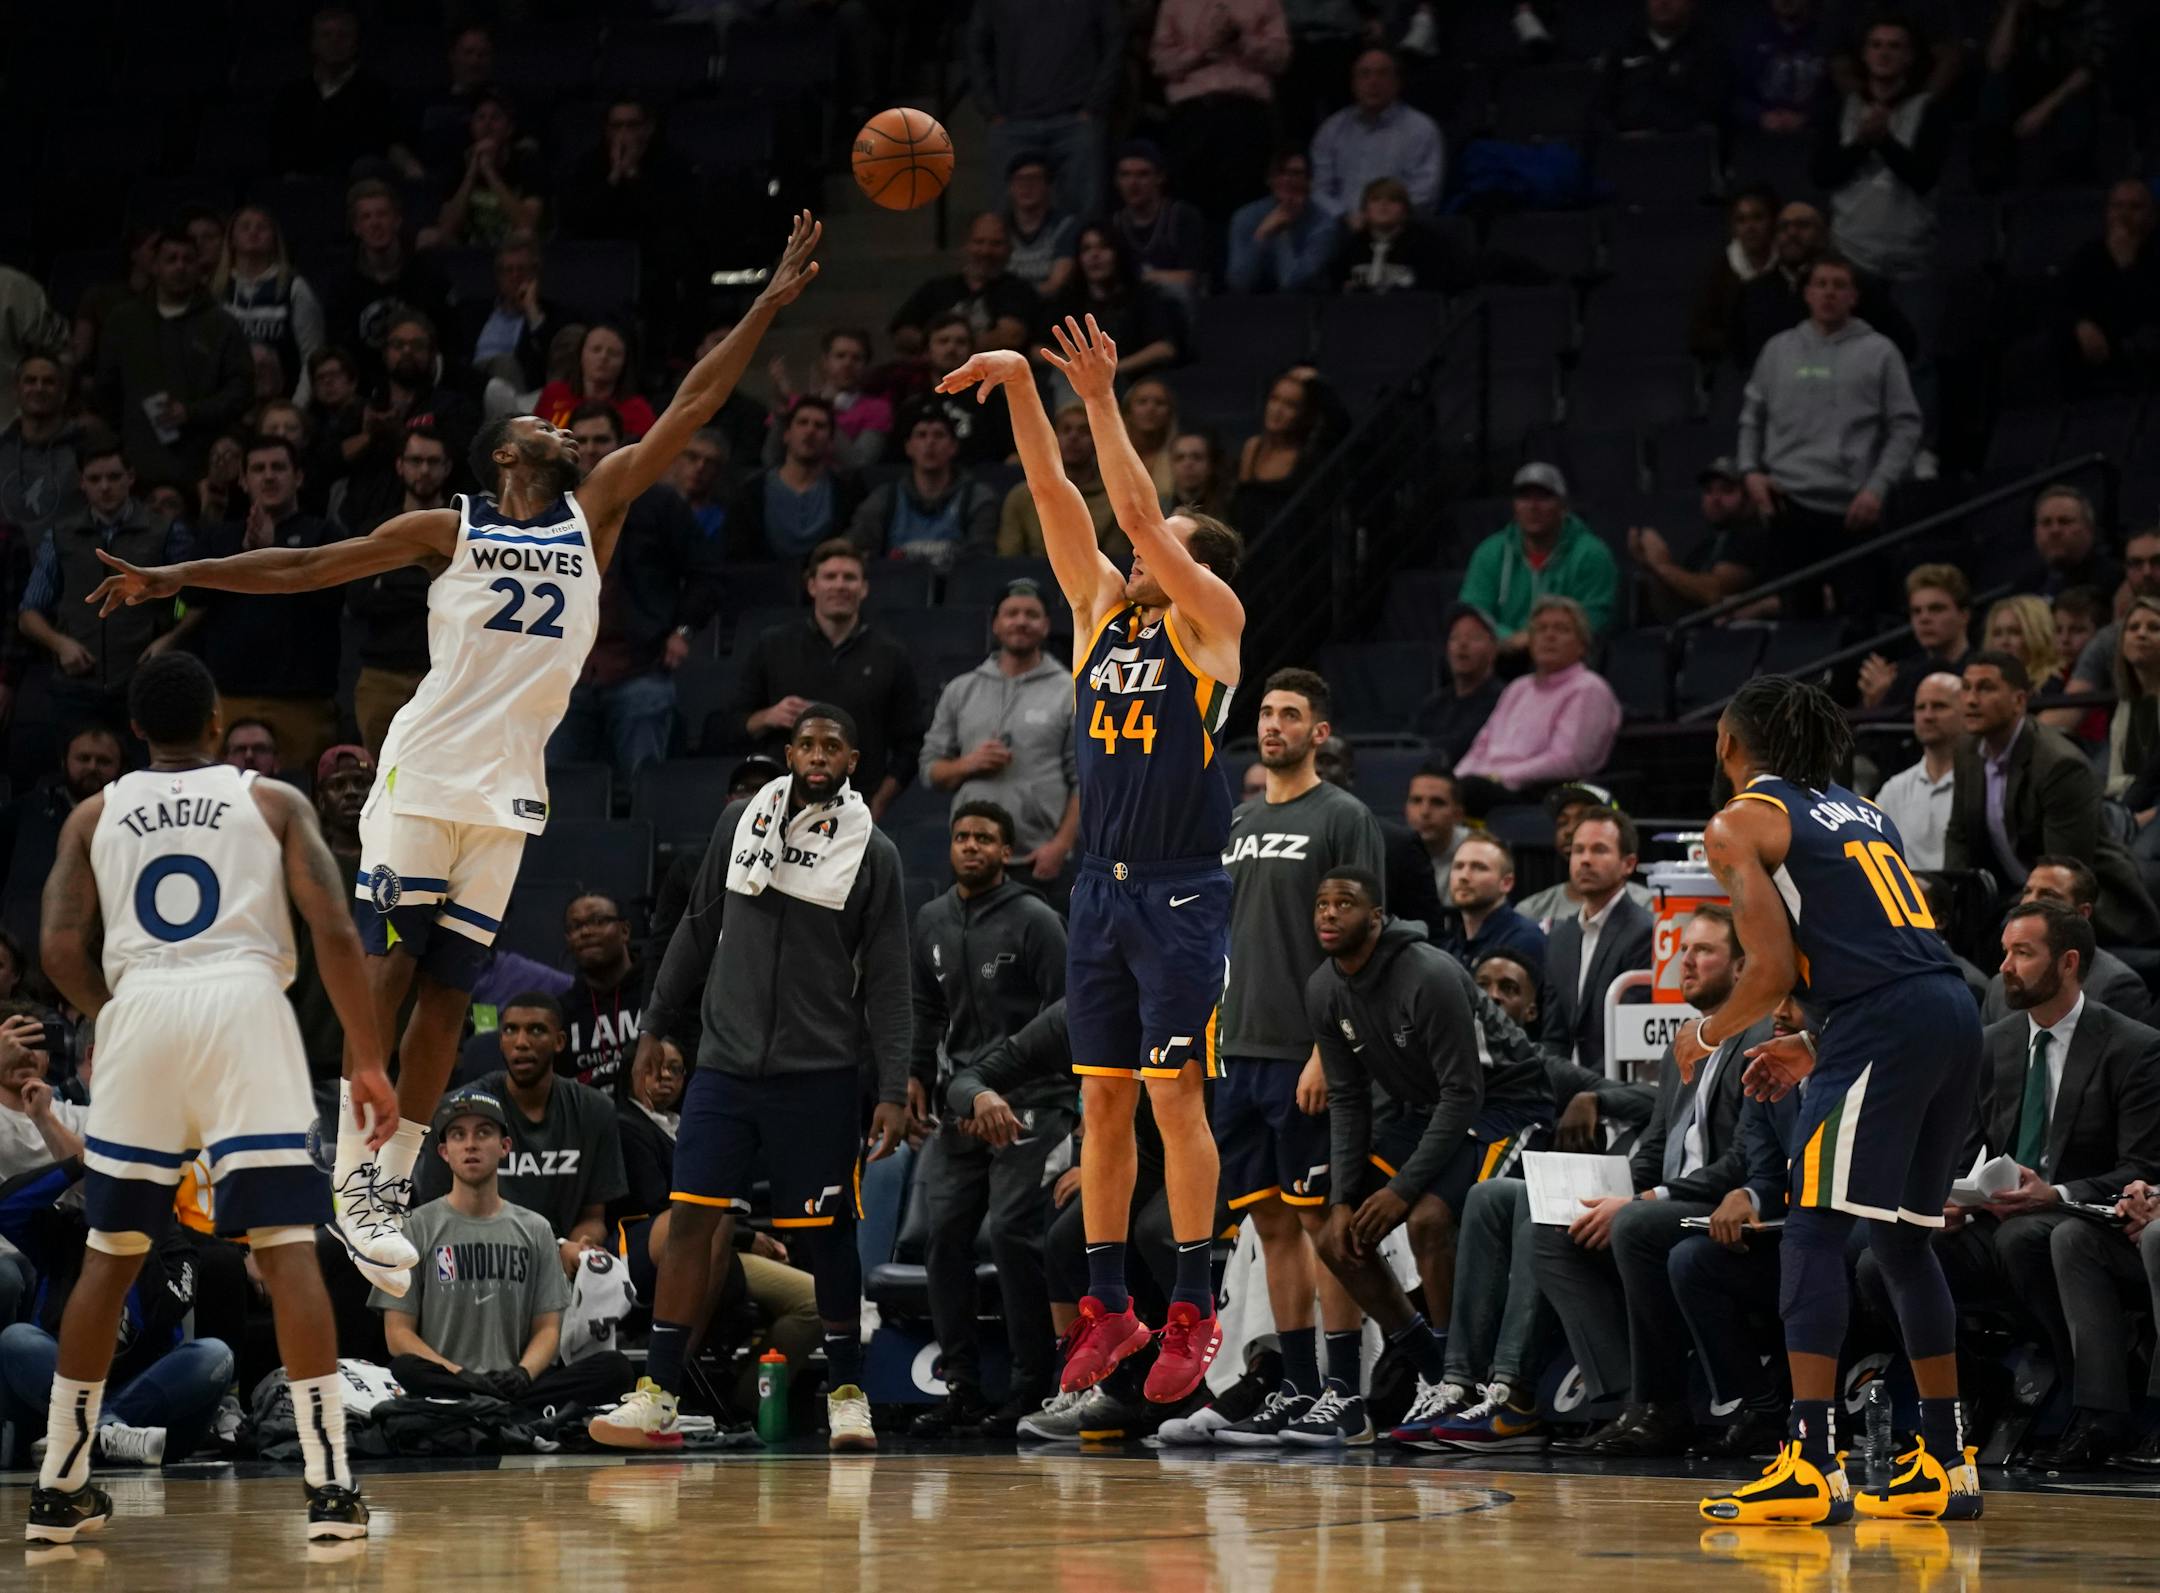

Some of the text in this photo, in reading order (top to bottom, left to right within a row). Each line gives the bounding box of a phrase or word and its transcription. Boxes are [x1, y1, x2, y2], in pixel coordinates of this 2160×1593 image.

[551, 523, 576, 535] fitbit
[471, 547, 583, 578] WOLVES
[483, 576, 566, 639] 22
[1089, 646, 1168, 695] JAZZ
[1088, 699, 1158, 755] 44
[118, 797, 232, 838] TEAGUE
[1808, 800, 1883, 834] CONLEY
[1221, 832, 1311, 866] JAZZ
[134, 853, 221, 942] 0
[1842, 839, 1937, 930] 10
[570, 1008, 641, 1053] I AM
[497, 1149, 581, 1177] JAZZ
[454, 1242, 529, 1283] WOLVES
